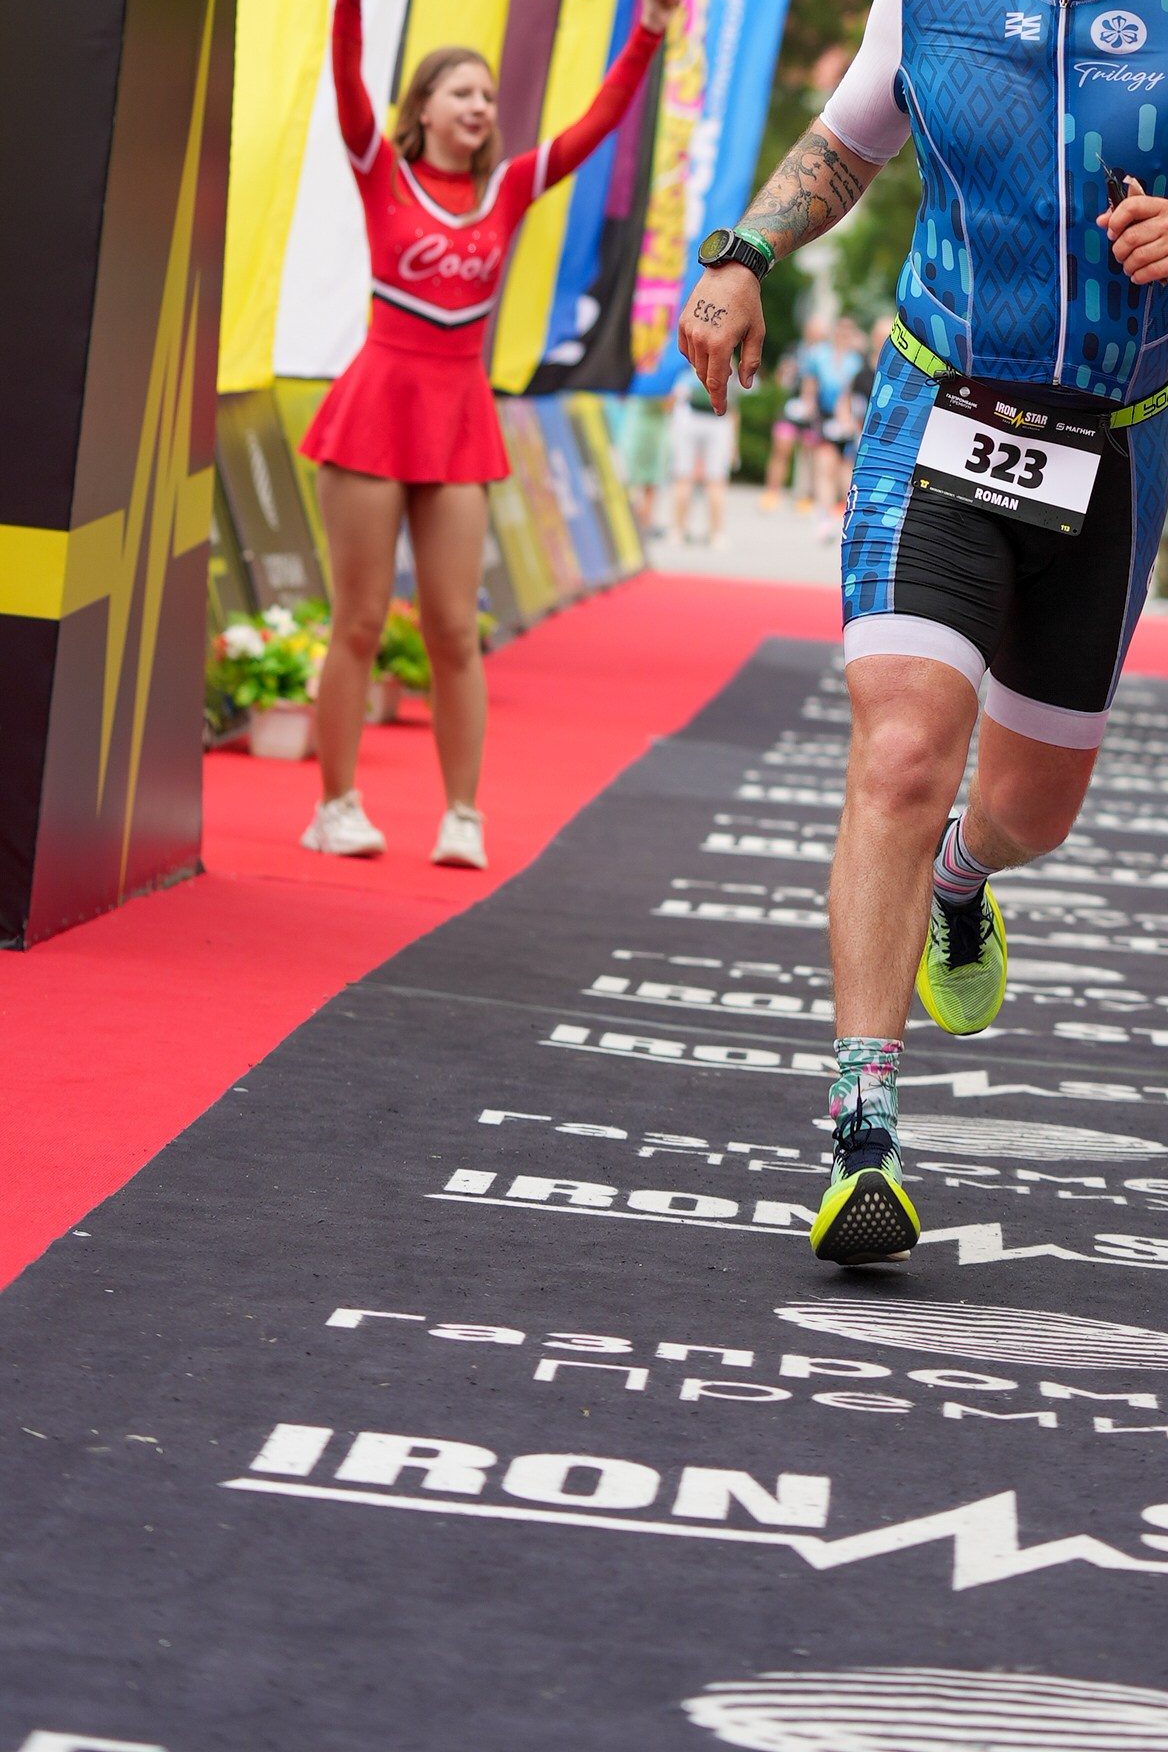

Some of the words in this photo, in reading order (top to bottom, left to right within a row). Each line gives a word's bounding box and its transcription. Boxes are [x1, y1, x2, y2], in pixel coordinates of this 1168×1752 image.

[1073, 61, 1166, 91] Trilogy
[398, 233, 502, 282] Cool
[994, 401, 1016, 418] IRON
[1024, 411, 1049, 426] STAR
[1065, 424, 1096, 437] МАГНИТ
[965, 432, 1048, 489] 323
[974, 487, 1019, 511] ROMAN
[591, 975, 835, 1015] IRO
[248, 1422, 832, 1529] IRON
